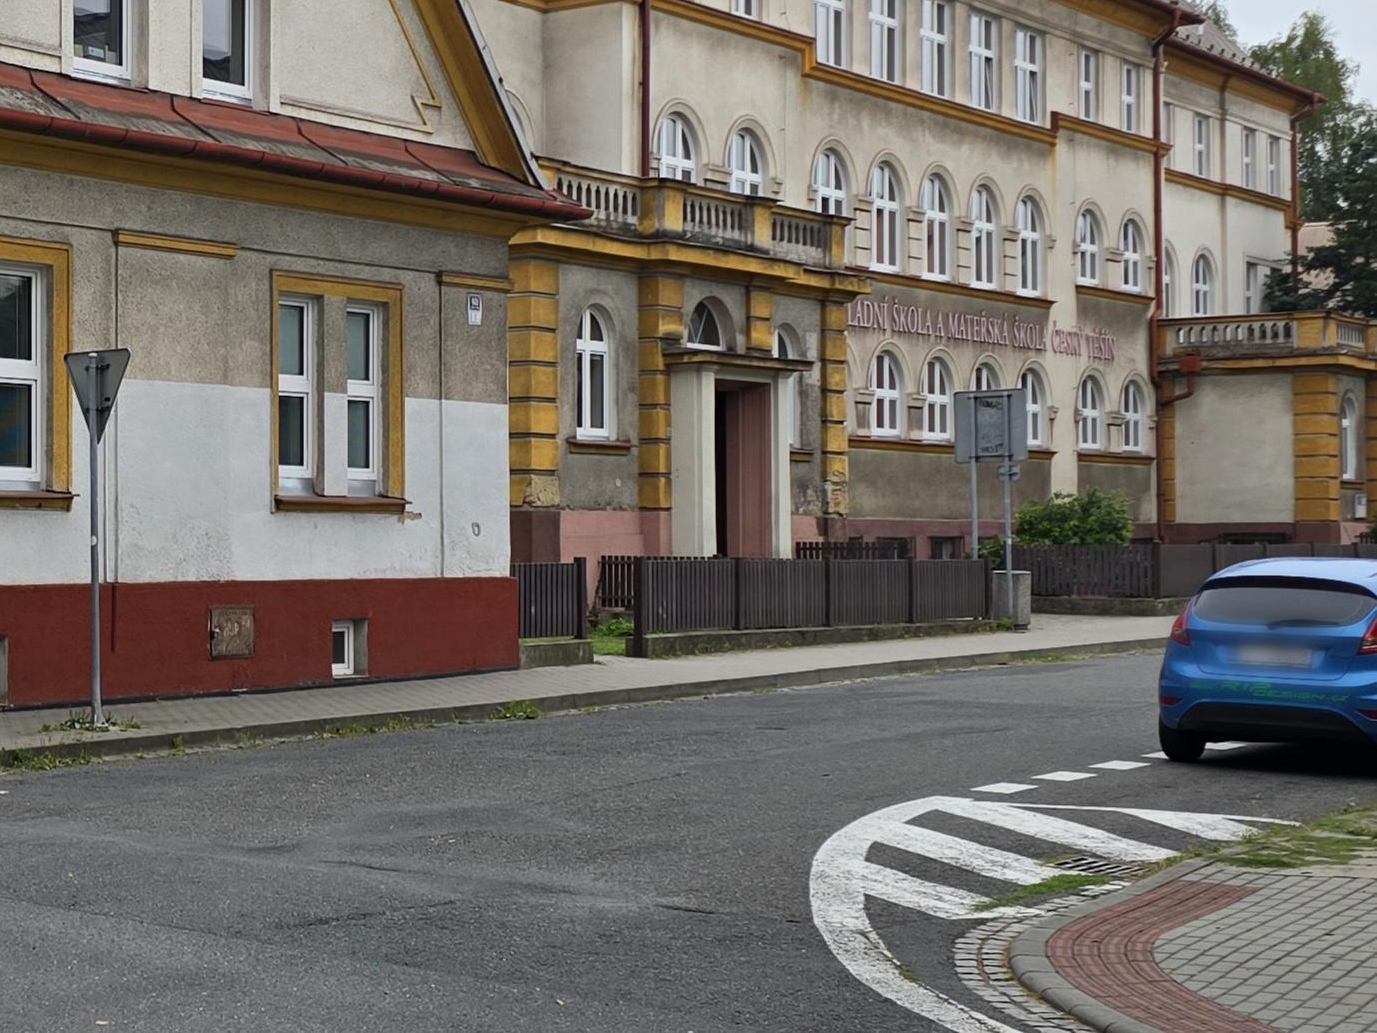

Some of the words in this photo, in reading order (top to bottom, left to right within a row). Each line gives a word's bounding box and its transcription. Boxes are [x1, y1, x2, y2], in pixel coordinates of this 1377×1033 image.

[847, 295, 888, 330] LADNÍ
[893, 297, 932, 334] ŠKOLA
[936, 311, 944, 336] A
[947, 310, 1009, 345] MATEŘSKÁ
[1013, 315, 1047, 351] ŠKOLA
